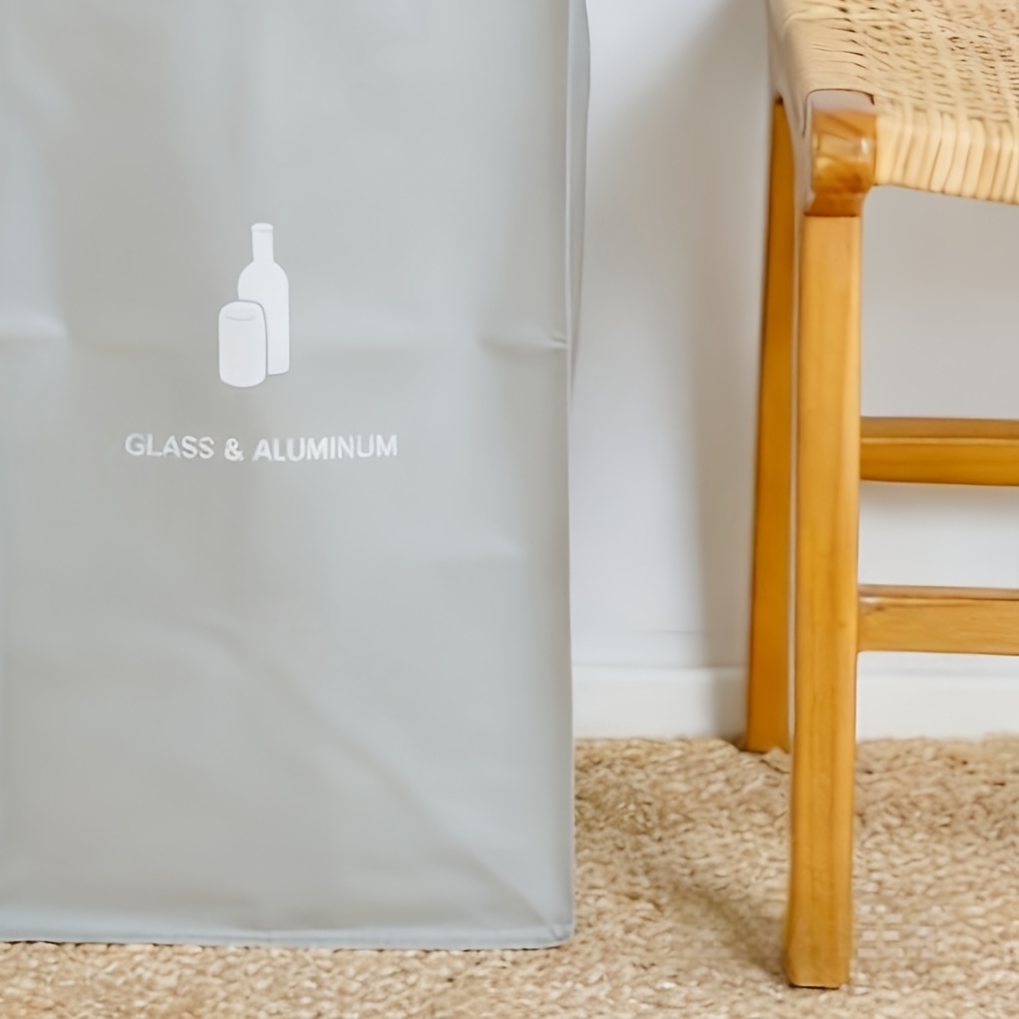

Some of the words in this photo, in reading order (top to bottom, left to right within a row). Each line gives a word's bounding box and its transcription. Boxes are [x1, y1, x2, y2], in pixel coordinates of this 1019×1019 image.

[125, 433, 214, 460] GLASS
[224, 437, 244, 461] &
[252, 434, 398, 462] ALUMINUM
